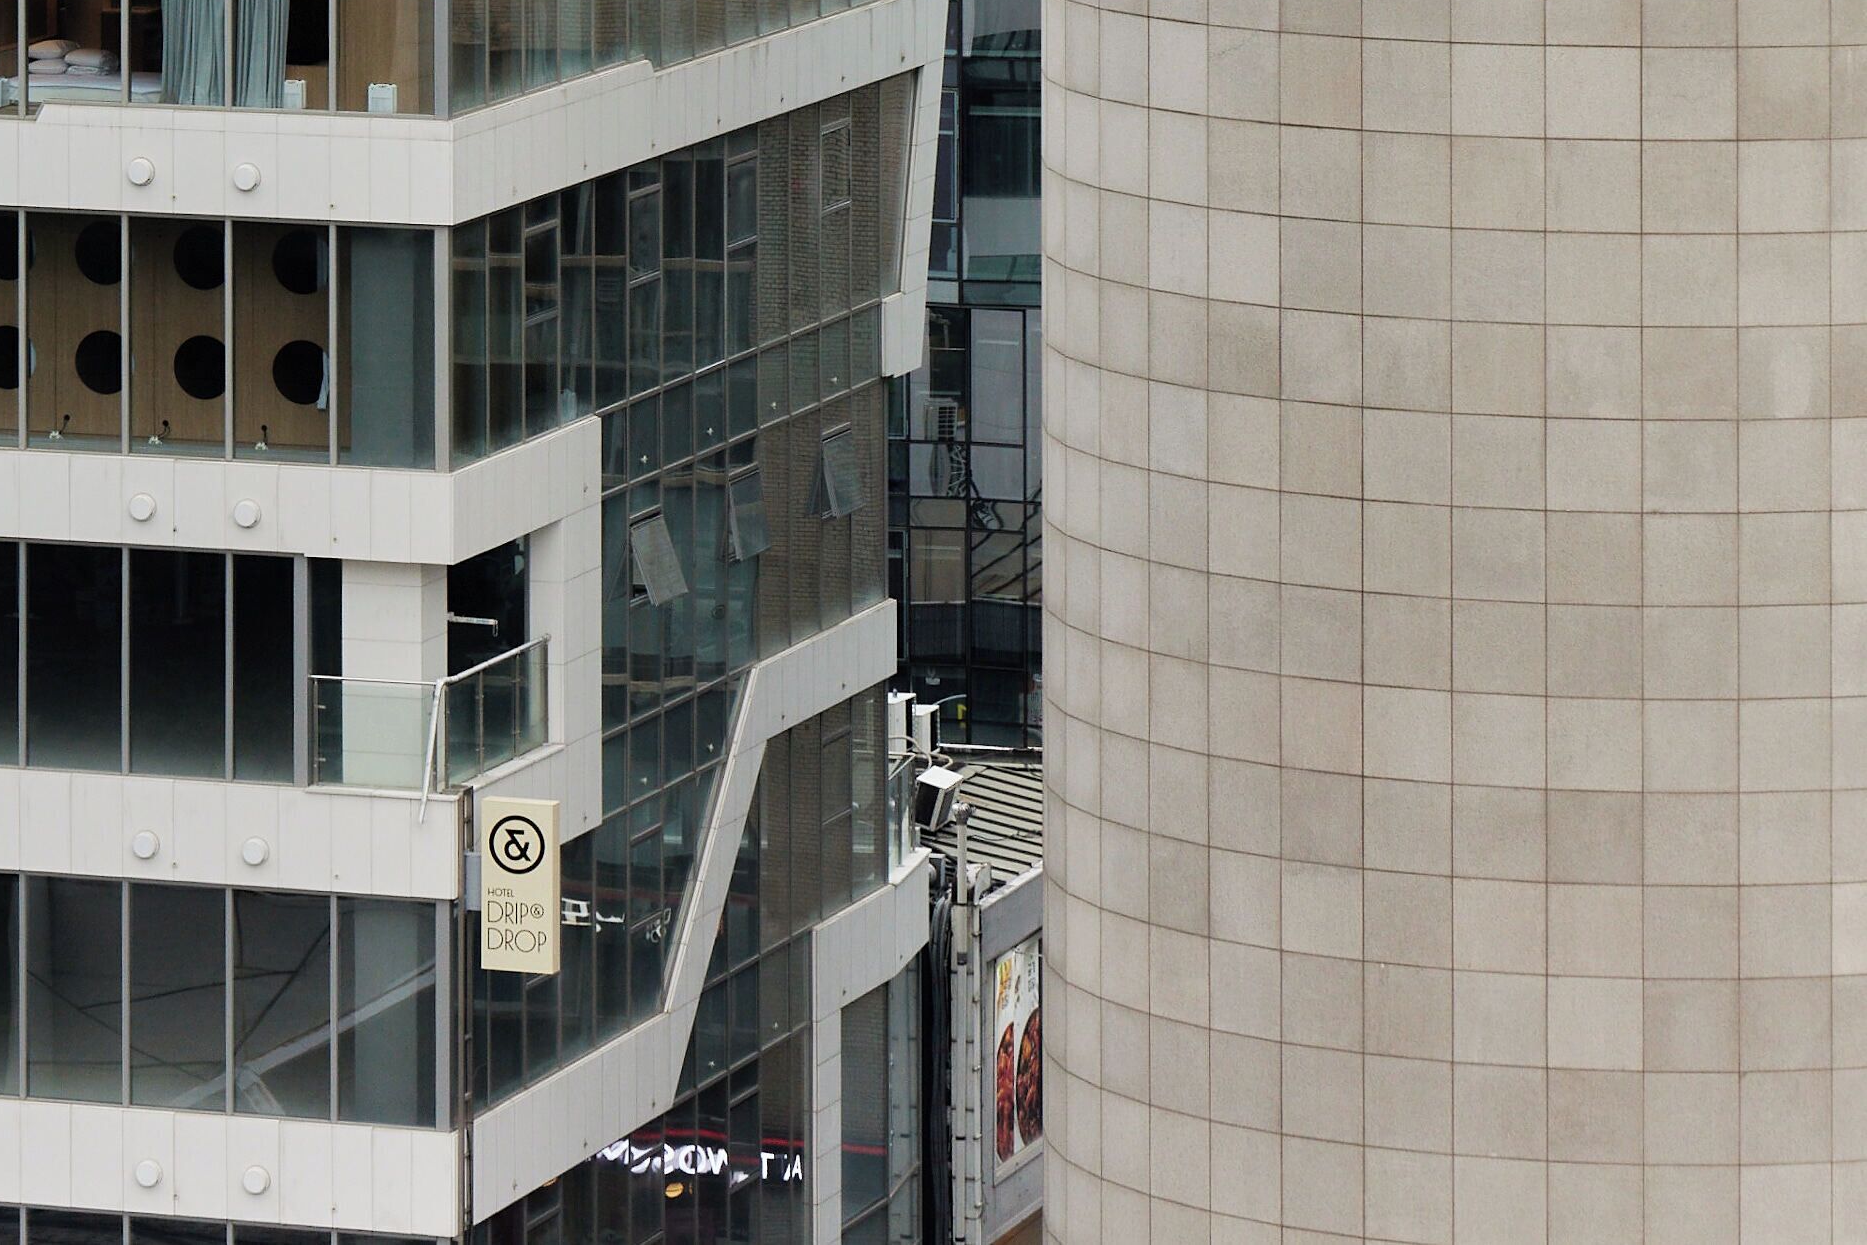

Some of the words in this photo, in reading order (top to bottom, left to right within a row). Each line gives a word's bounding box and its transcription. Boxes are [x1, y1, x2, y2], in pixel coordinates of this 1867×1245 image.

[487, 887, 514, 898] HOTEL
[487, 900, 529, 925] DRIP
[487, 927, 547, 954] DROP
